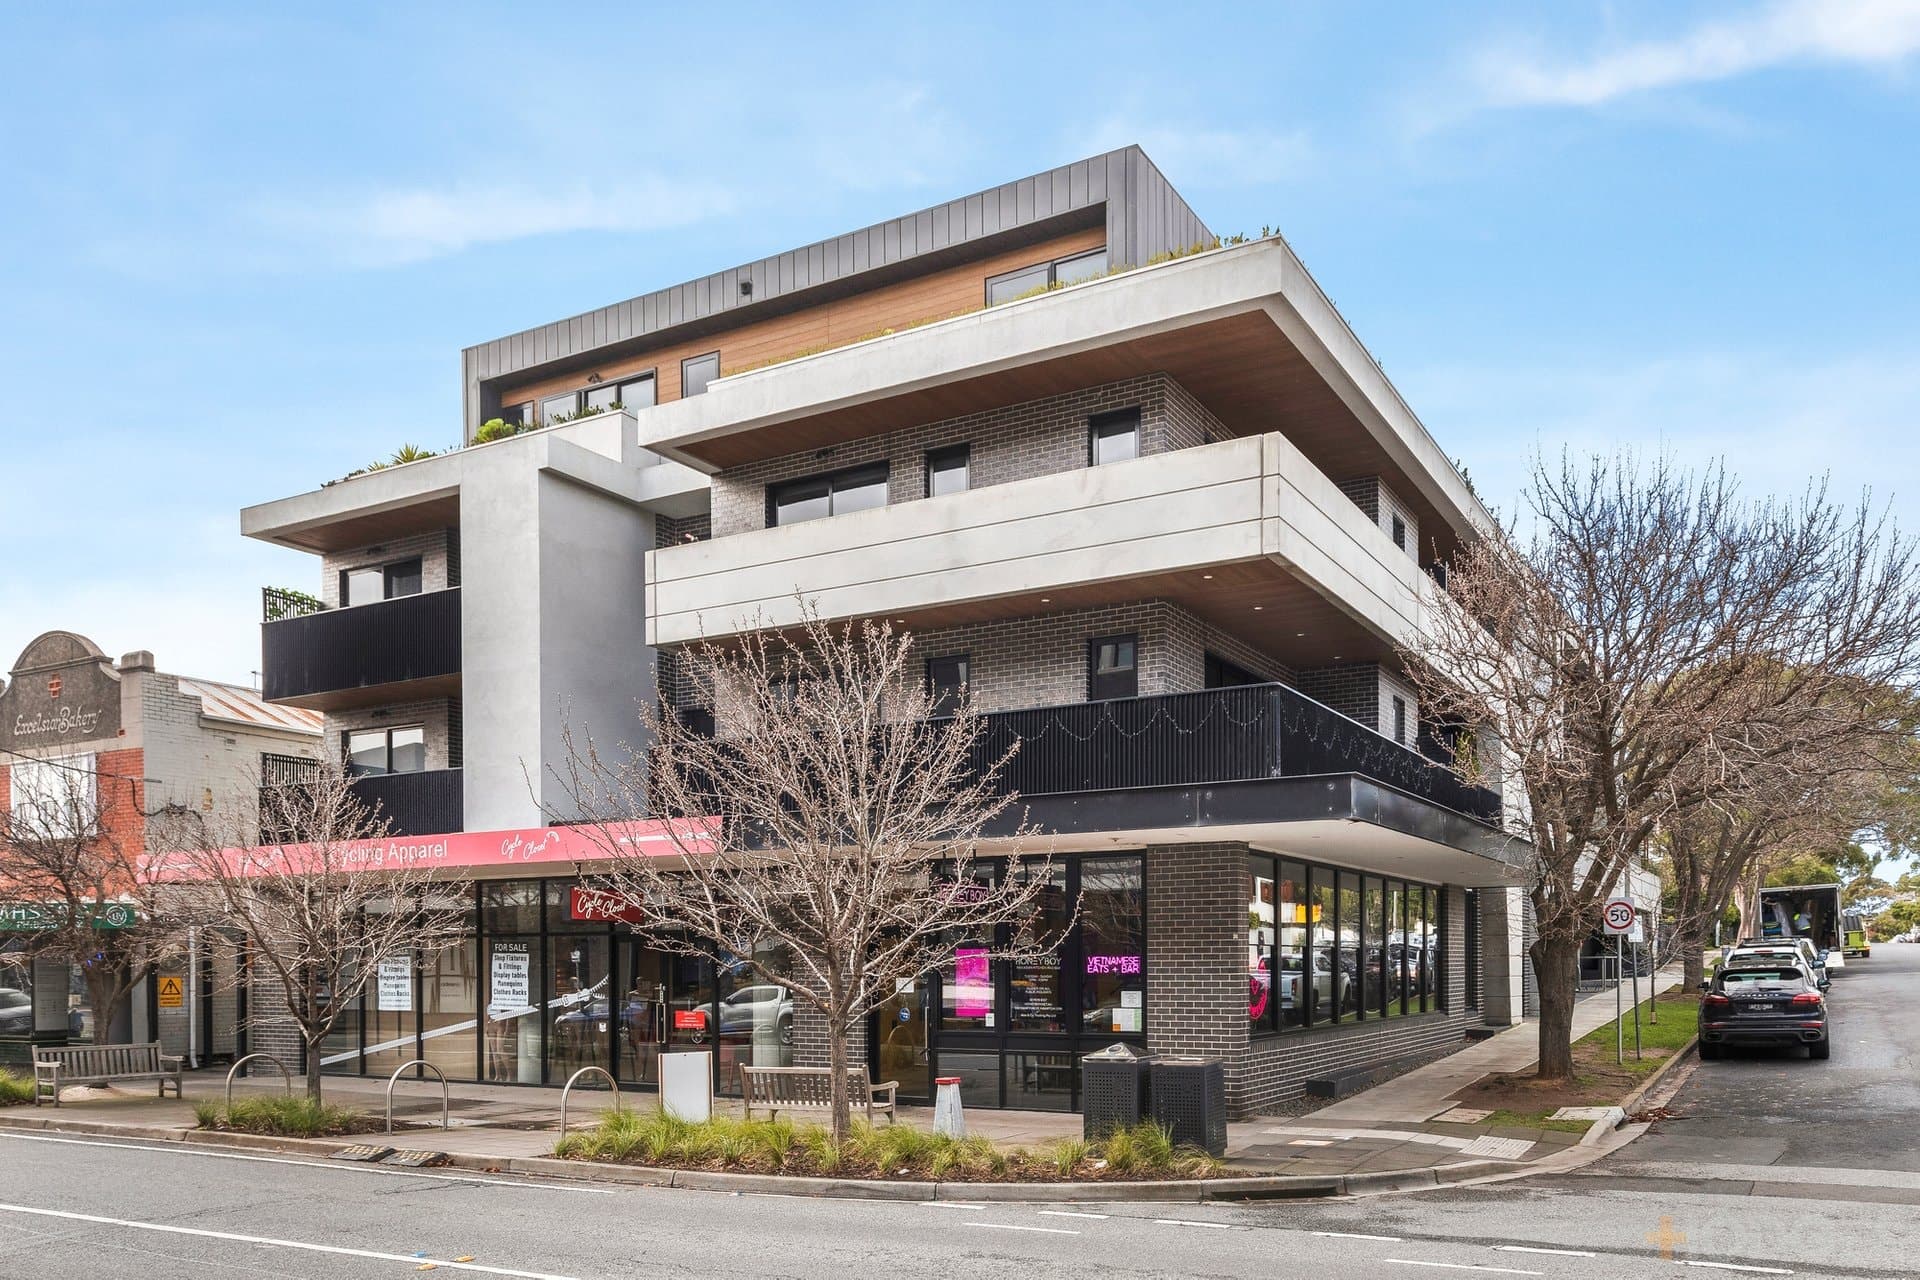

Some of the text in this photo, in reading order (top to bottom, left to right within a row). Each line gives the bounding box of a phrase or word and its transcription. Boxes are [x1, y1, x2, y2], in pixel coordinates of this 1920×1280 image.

[58, 704, 101, 733] Bakery
[388, 840, 447, 864] Apparel
[501, 834, 547, 859] Cycle Closet
[577, 893, 626, 919] Cycle Closet
[1610, 909, 1629, 922] 50
[494, 943, 527, 951] FOR SALE
[1087, 956, 1140, 965] VIETNAMESE
[1087, 964, 1109, 973] EATS
[1121, 964, 1140, 973] BAR
